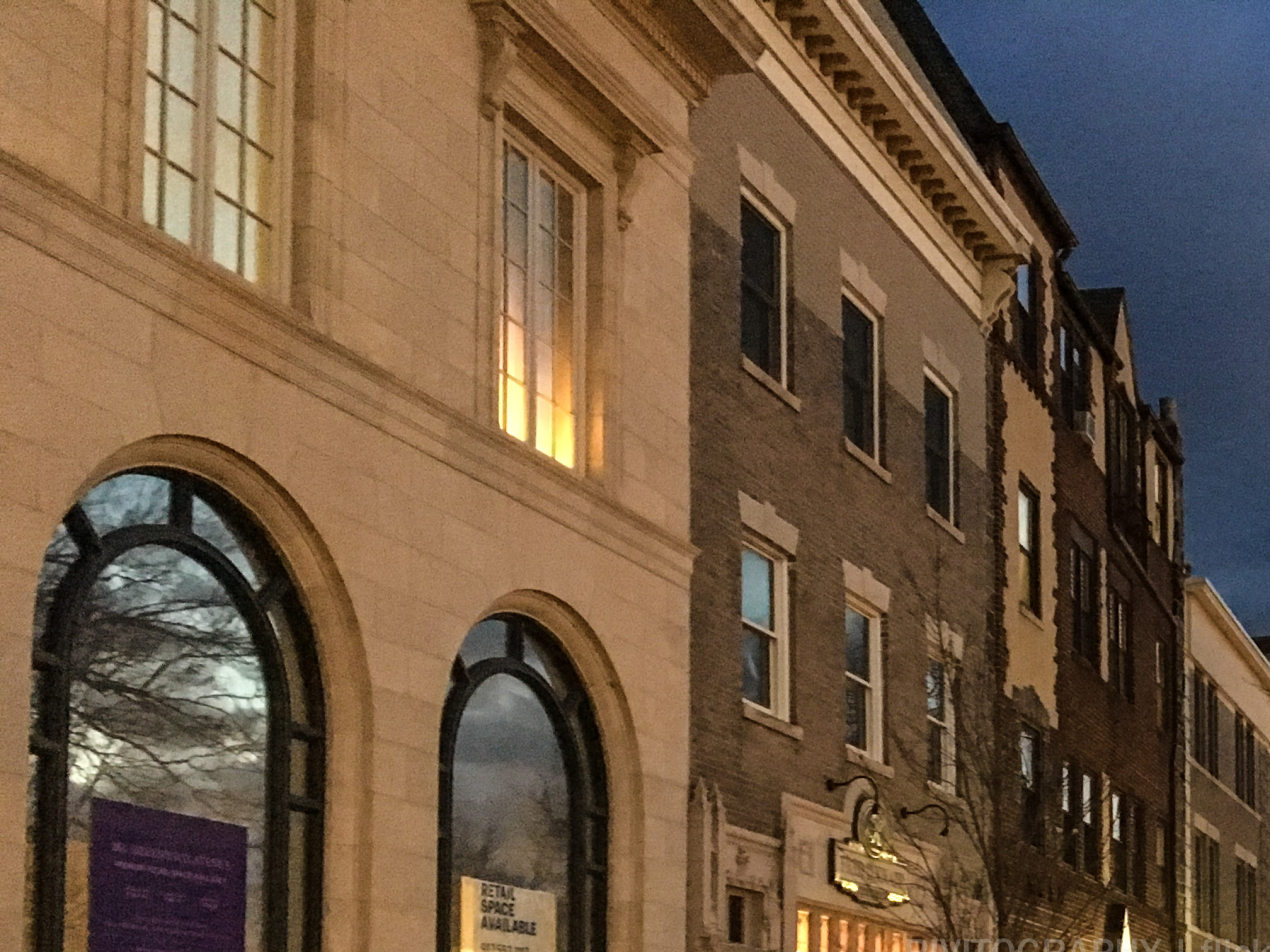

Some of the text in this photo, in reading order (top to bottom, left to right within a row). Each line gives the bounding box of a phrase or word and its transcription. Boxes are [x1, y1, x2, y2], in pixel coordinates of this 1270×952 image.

[481, 883, 515, 901] RETAIL
[481, 899, 515, 917] SPACE
[481, 915, 537, 936] AVAILABLE
